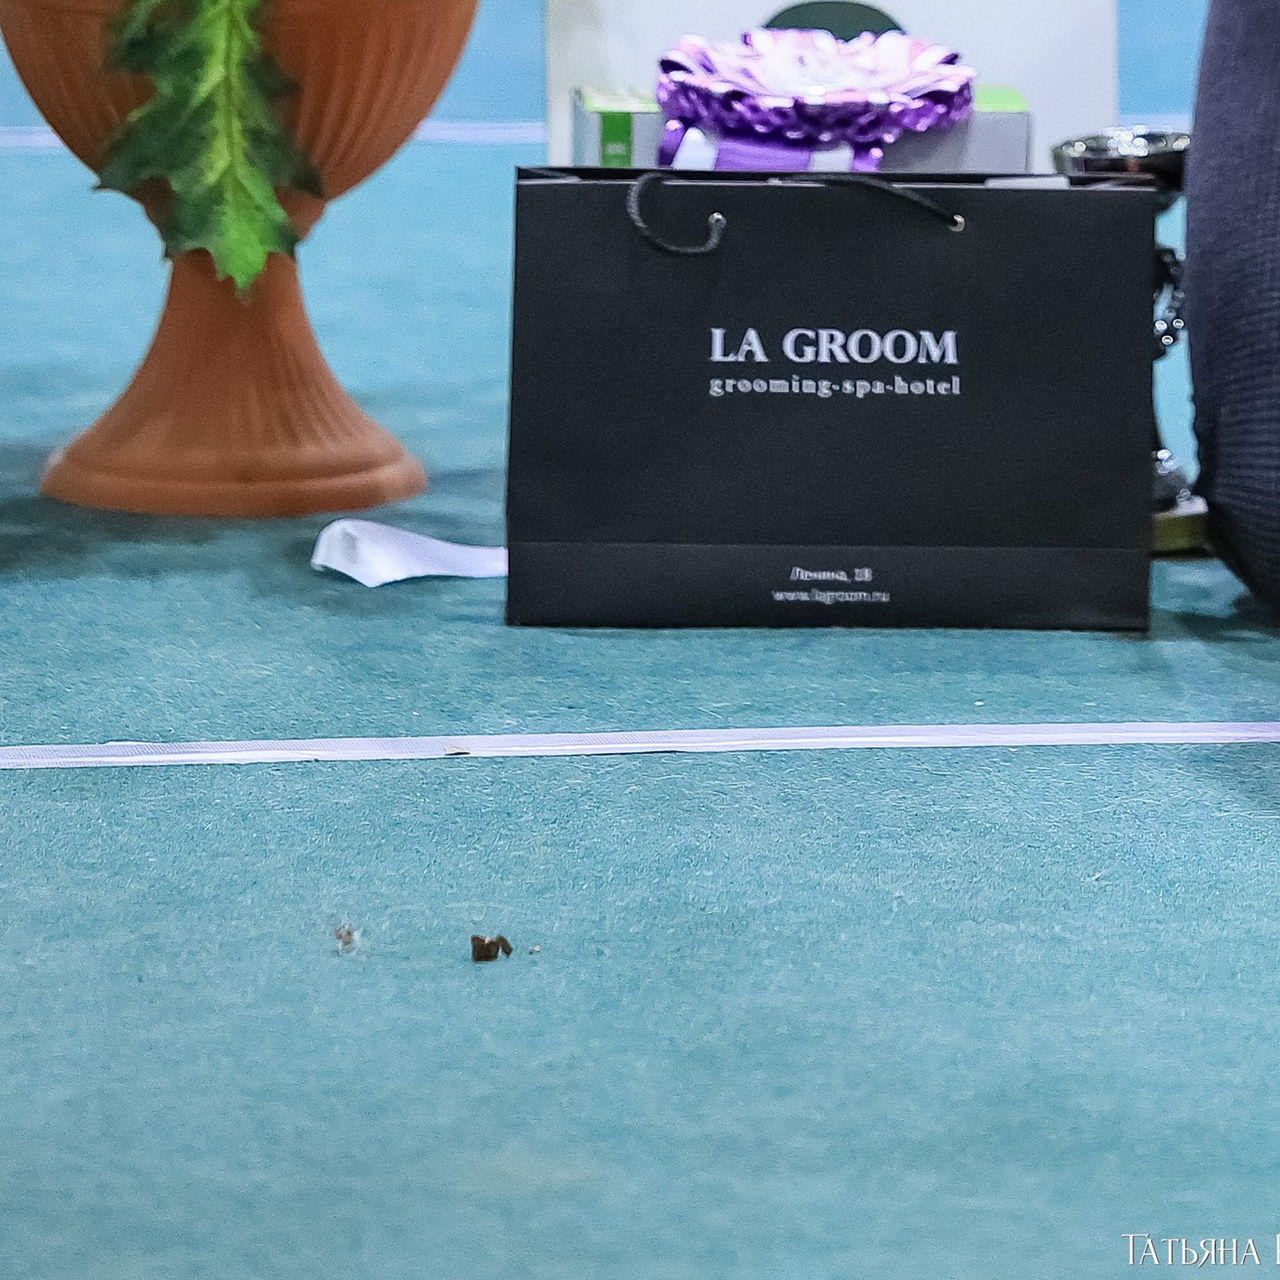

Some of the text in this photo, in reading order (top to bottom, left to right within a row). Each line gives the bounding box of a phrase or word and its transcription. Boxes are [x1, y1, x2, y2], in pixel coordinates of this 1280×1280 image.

[710, 326, 960, 364] LA GROOM
[708, 374, 961, 399] grooming-spa-hotel
